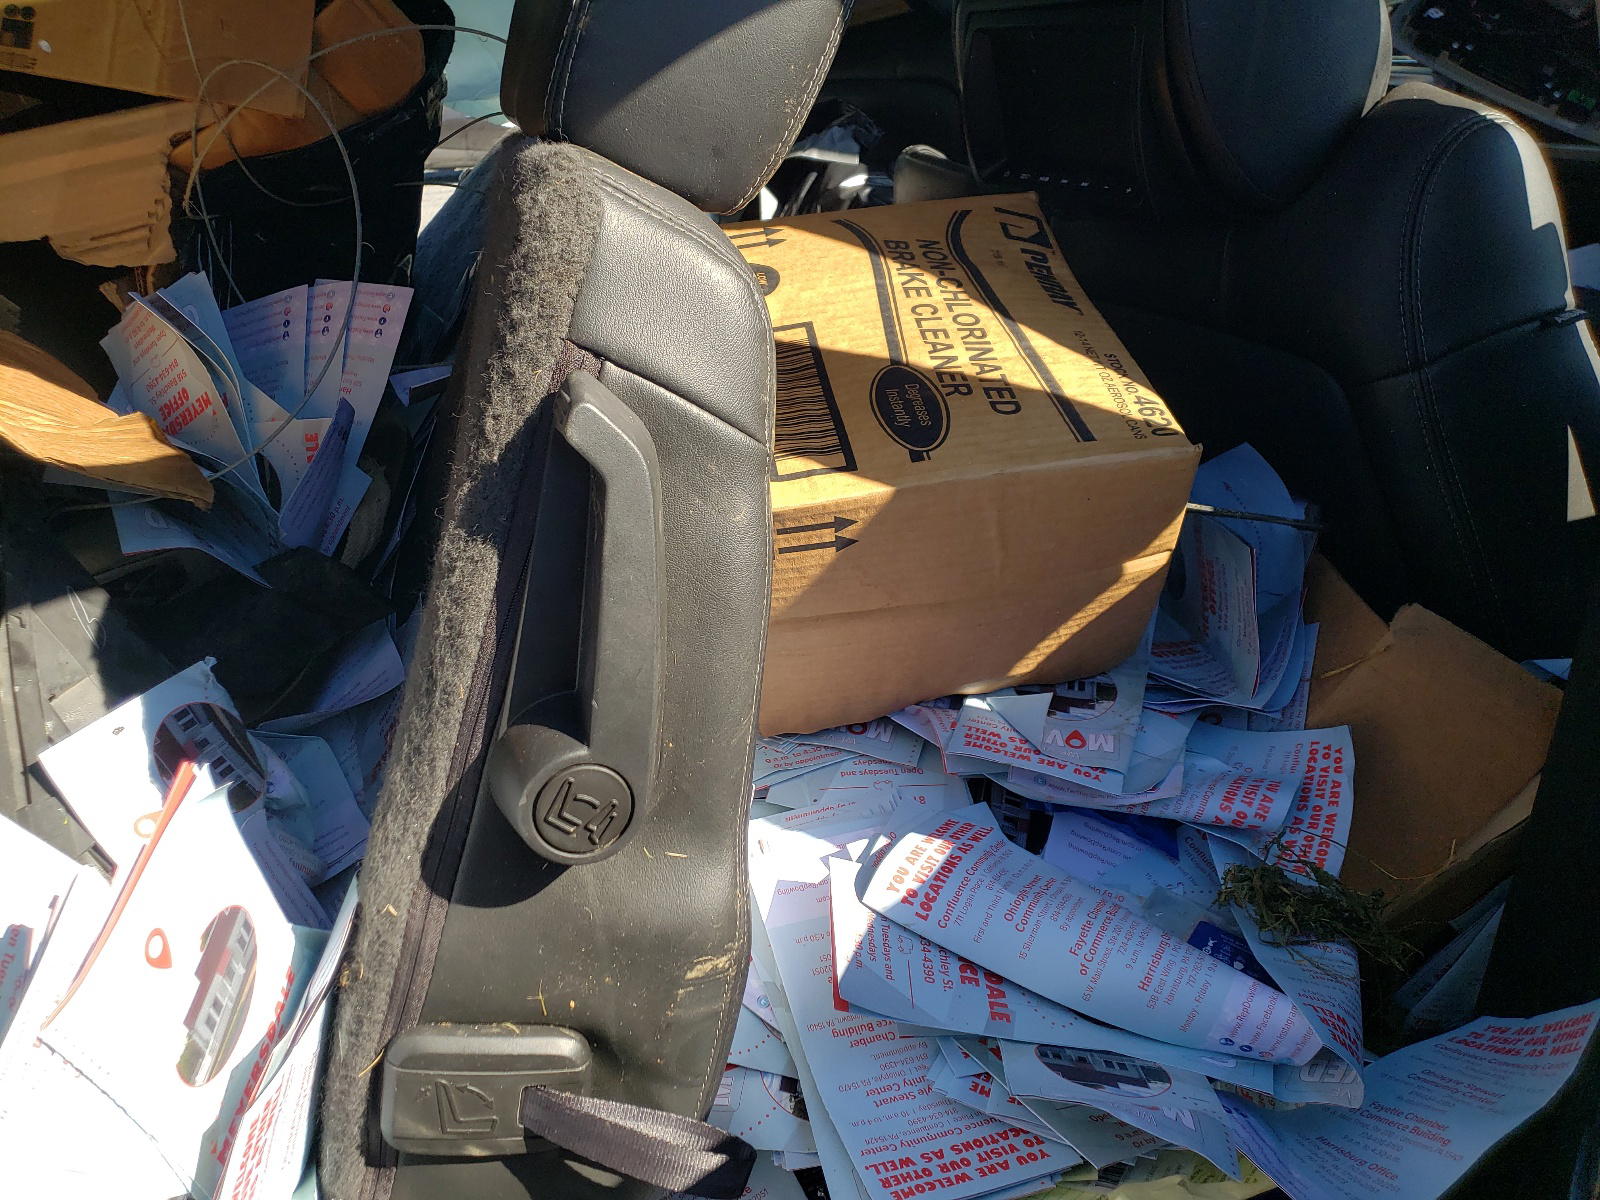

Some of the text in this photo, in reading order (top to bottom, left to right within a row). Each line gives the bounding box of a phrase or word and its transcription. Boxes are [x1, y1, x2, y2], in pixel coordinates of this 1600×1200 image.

[883, 239, 974, 397] BRAKE CLEANER
[915, 238, 1021, 416] NON-CHLORINATED
[156, 386, 191, 422] OFFICE
[883, 387, 913, 427] Instantly
[903, 382, 933, 427] Degreases
[1131, 397, 1179, 436] 4620
[961, 722, 1028, 746] AS WELL.
[962, 731, 1009, 749] OTHER
[965, 716, 998, 729] Center
[839, 766, 923, 777] Open Tuesdays and
[962, 738, 1103, 781] YOU ARE WELCOME
[1326, 747, 1344, 809] YOU ARE
[1239, 782, 1261, 808] VISIT
[1287, 739, 1321, 836] LOCATIONS AS
[1306, 742, 1332, 831] TO VISIT OUR
[1252, 793, 1275, 822] ARE
[885, 816, 960, 895] YOU ARE WELCOME
[900, 820, 977, 908] TO VISIT OUR OTHER
[912, 823, 994, 922] LOCATIONS AS WELL.
[935, 874, 971, 930] Confluence
[958, 892, 977, 915] Logan
[879, 922, 895, 982] Tuesdays and
[1067, 918, 1095, 957] Fayette
[1077, 914, 1114, 977] of Commerce
[941, 977, 954, 992] St.
[1136, 938, 1171, 992] Harrisburg
[1193, 978, 1213, 1004] Friday
[830, 1021, 875, 1040] Building
[847, 1030, 896, 1049] Chamber
[215, 964, 297, 1166] MEYERSDALE
[864, 1081, 901, 1098] Center
[872, 1090, 917, 1109] Stewart
[952, 1111, 974, 1124] Place
[1358, 1107, 1452, 1147] Commerce Building
[1369, 1099, 1406, 1121] Fayette
[1408, 1112, 1450, 1132] Chamber
[859, 1125, 963, 1158] Community Center
[887, 1131, 898, 1140] PA
[863, 1147, 945, 1177] AS WELL.
[877, 1132, 1045, 1189] TO VISIT OUR OTHER
[889, 1146, 1050, 1200] YOU ARE WELCOME
[1315, 1134, 1367, 1170] Harrisburg
[1367, 1162, 1399, 1182] Office
